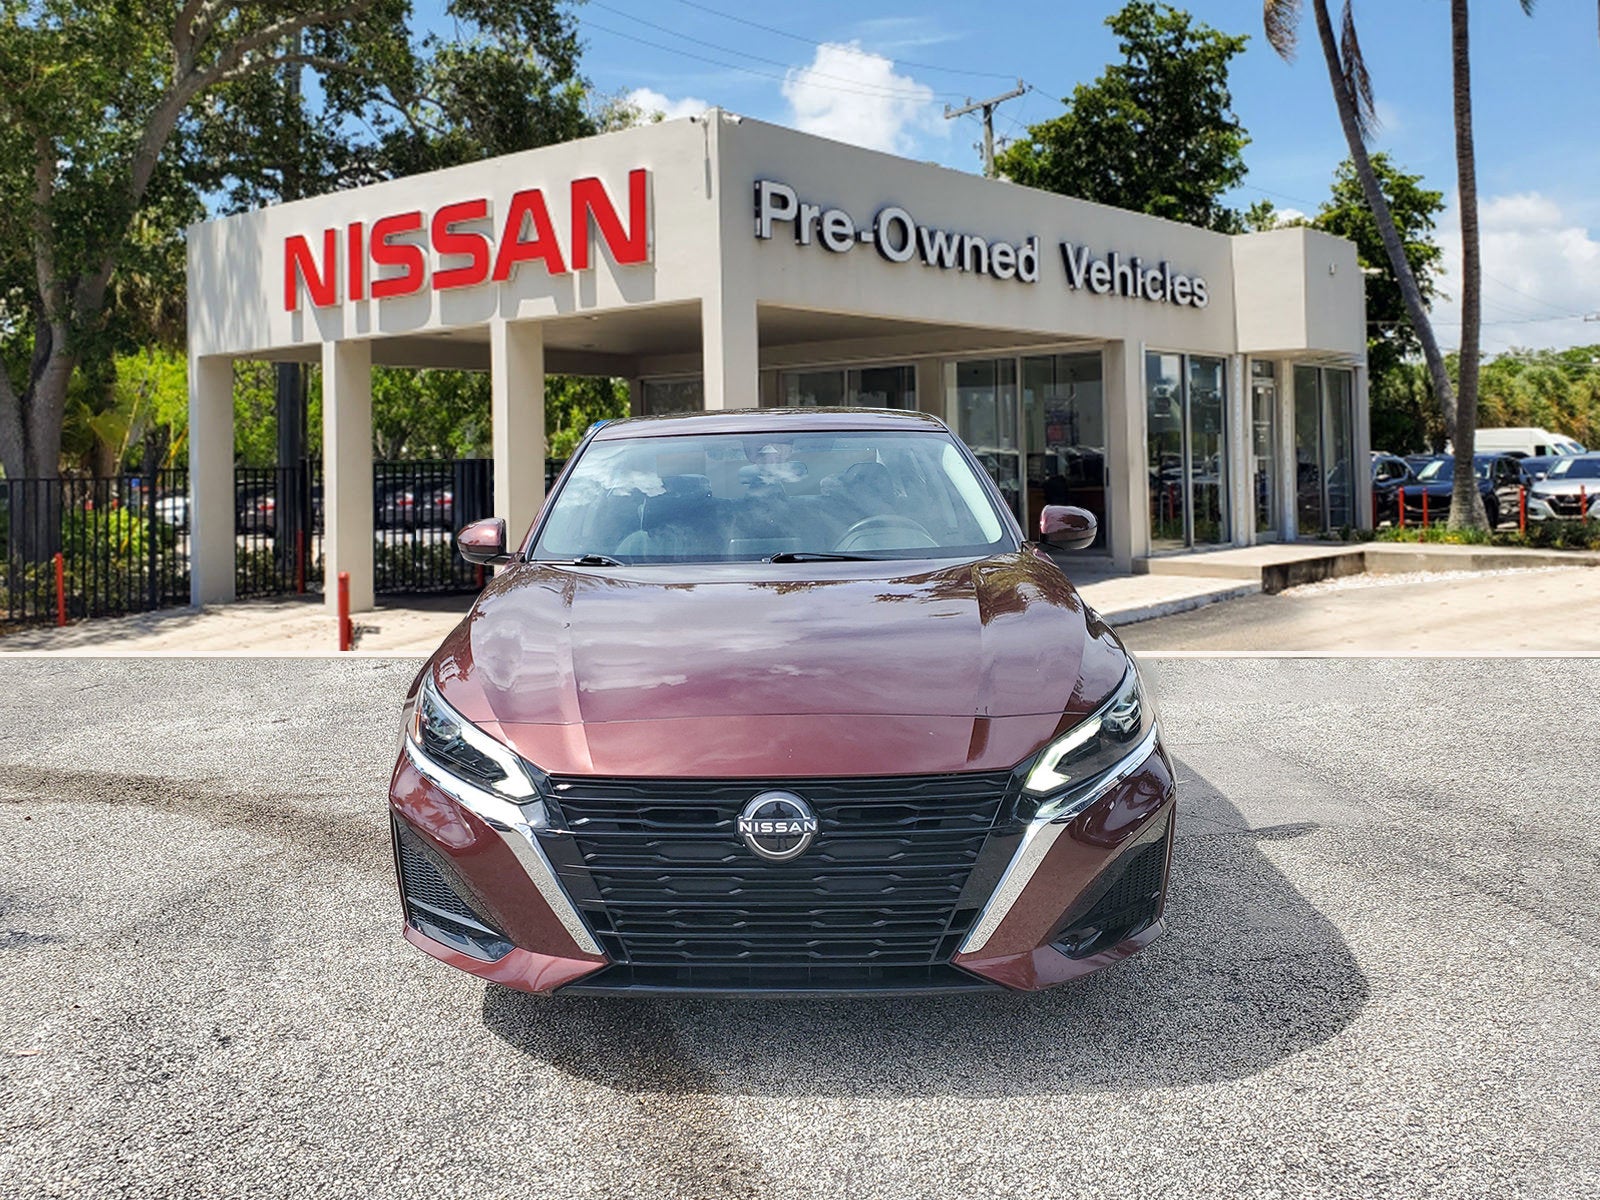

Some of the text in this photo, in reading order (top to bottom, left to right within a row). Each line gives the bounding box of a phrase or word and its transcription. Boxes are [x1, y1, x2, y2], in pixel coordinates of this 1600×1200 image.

[284, 168, 650, 312] NISSAN
[754, 179, 1209, 309] Pre-Owned Vehicles
[739, 821, 817, 833] NISSAN
